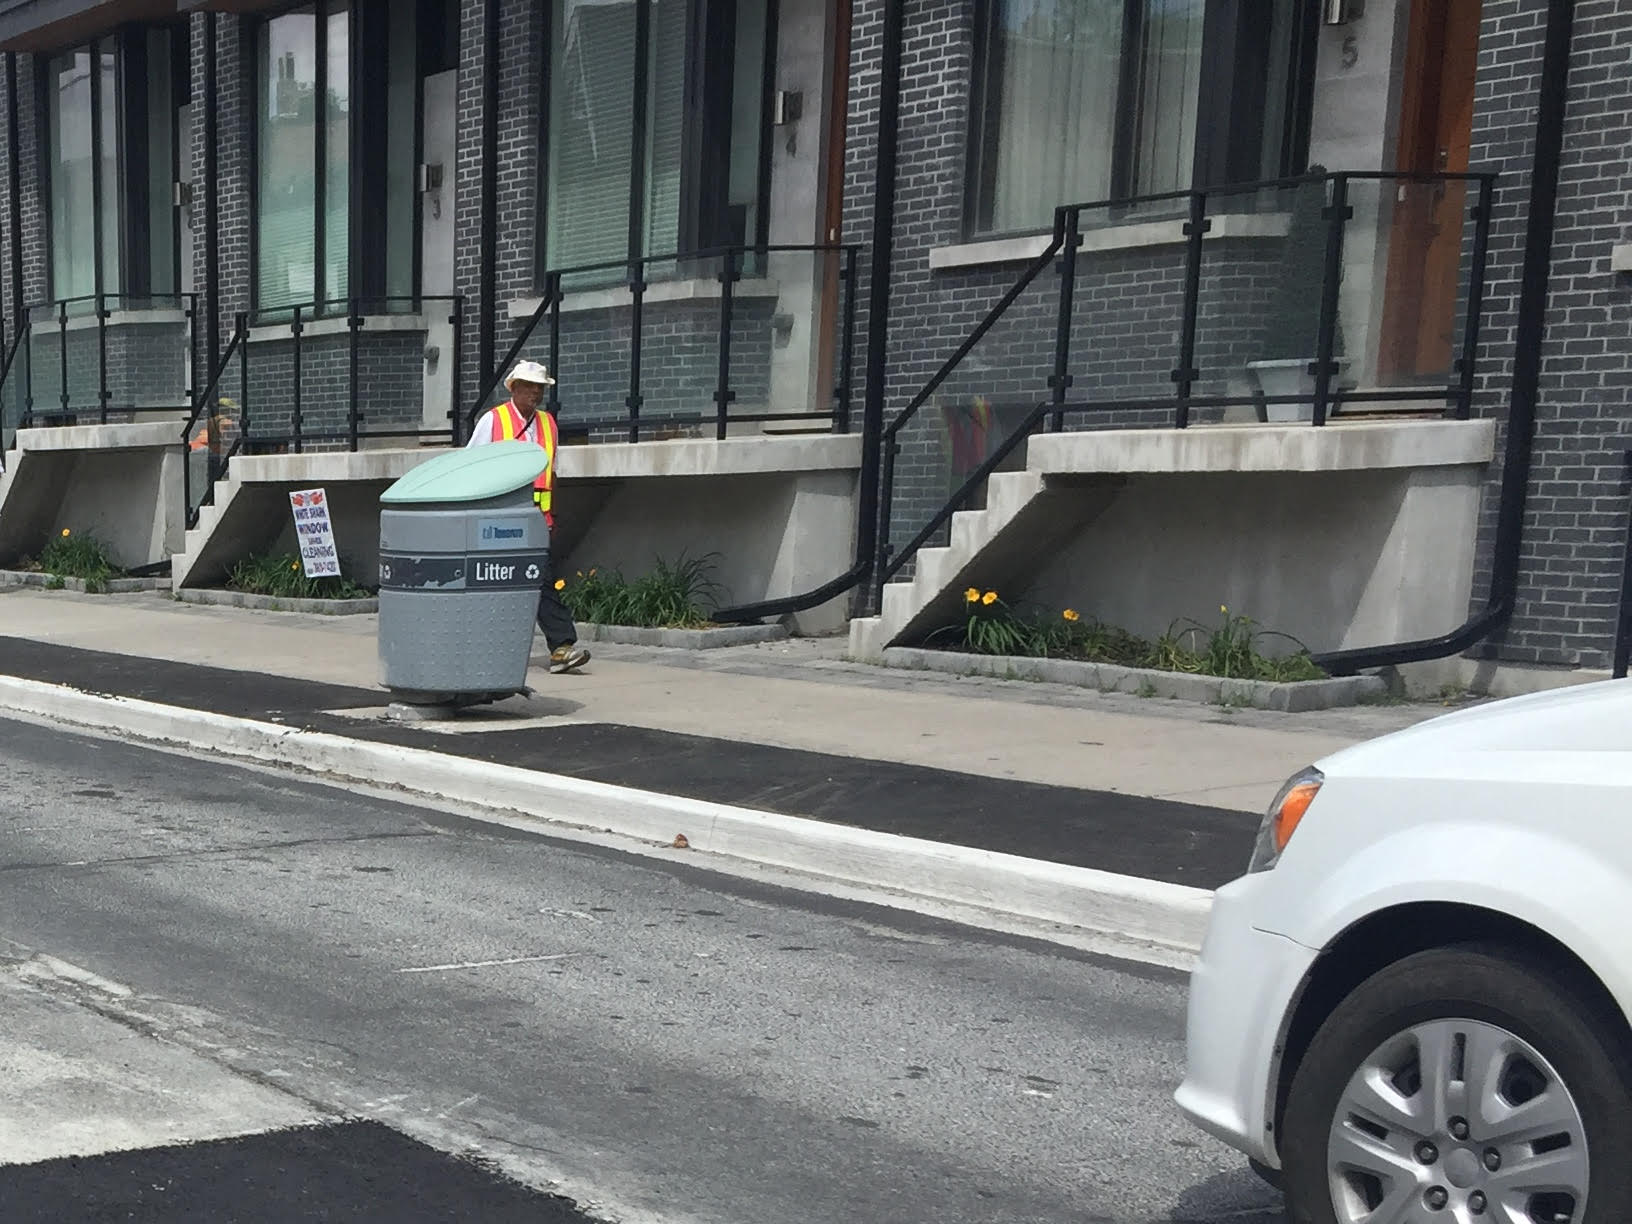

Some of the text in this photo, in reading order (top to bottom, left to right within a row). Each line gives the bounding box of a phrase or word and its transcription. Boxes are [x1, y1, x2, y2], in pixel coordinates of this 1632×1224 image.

[298, 521, 329, 534] WINDOW
[303, 544, 335, 558] CLEANING
[476, 562, 515, 580] Litter
